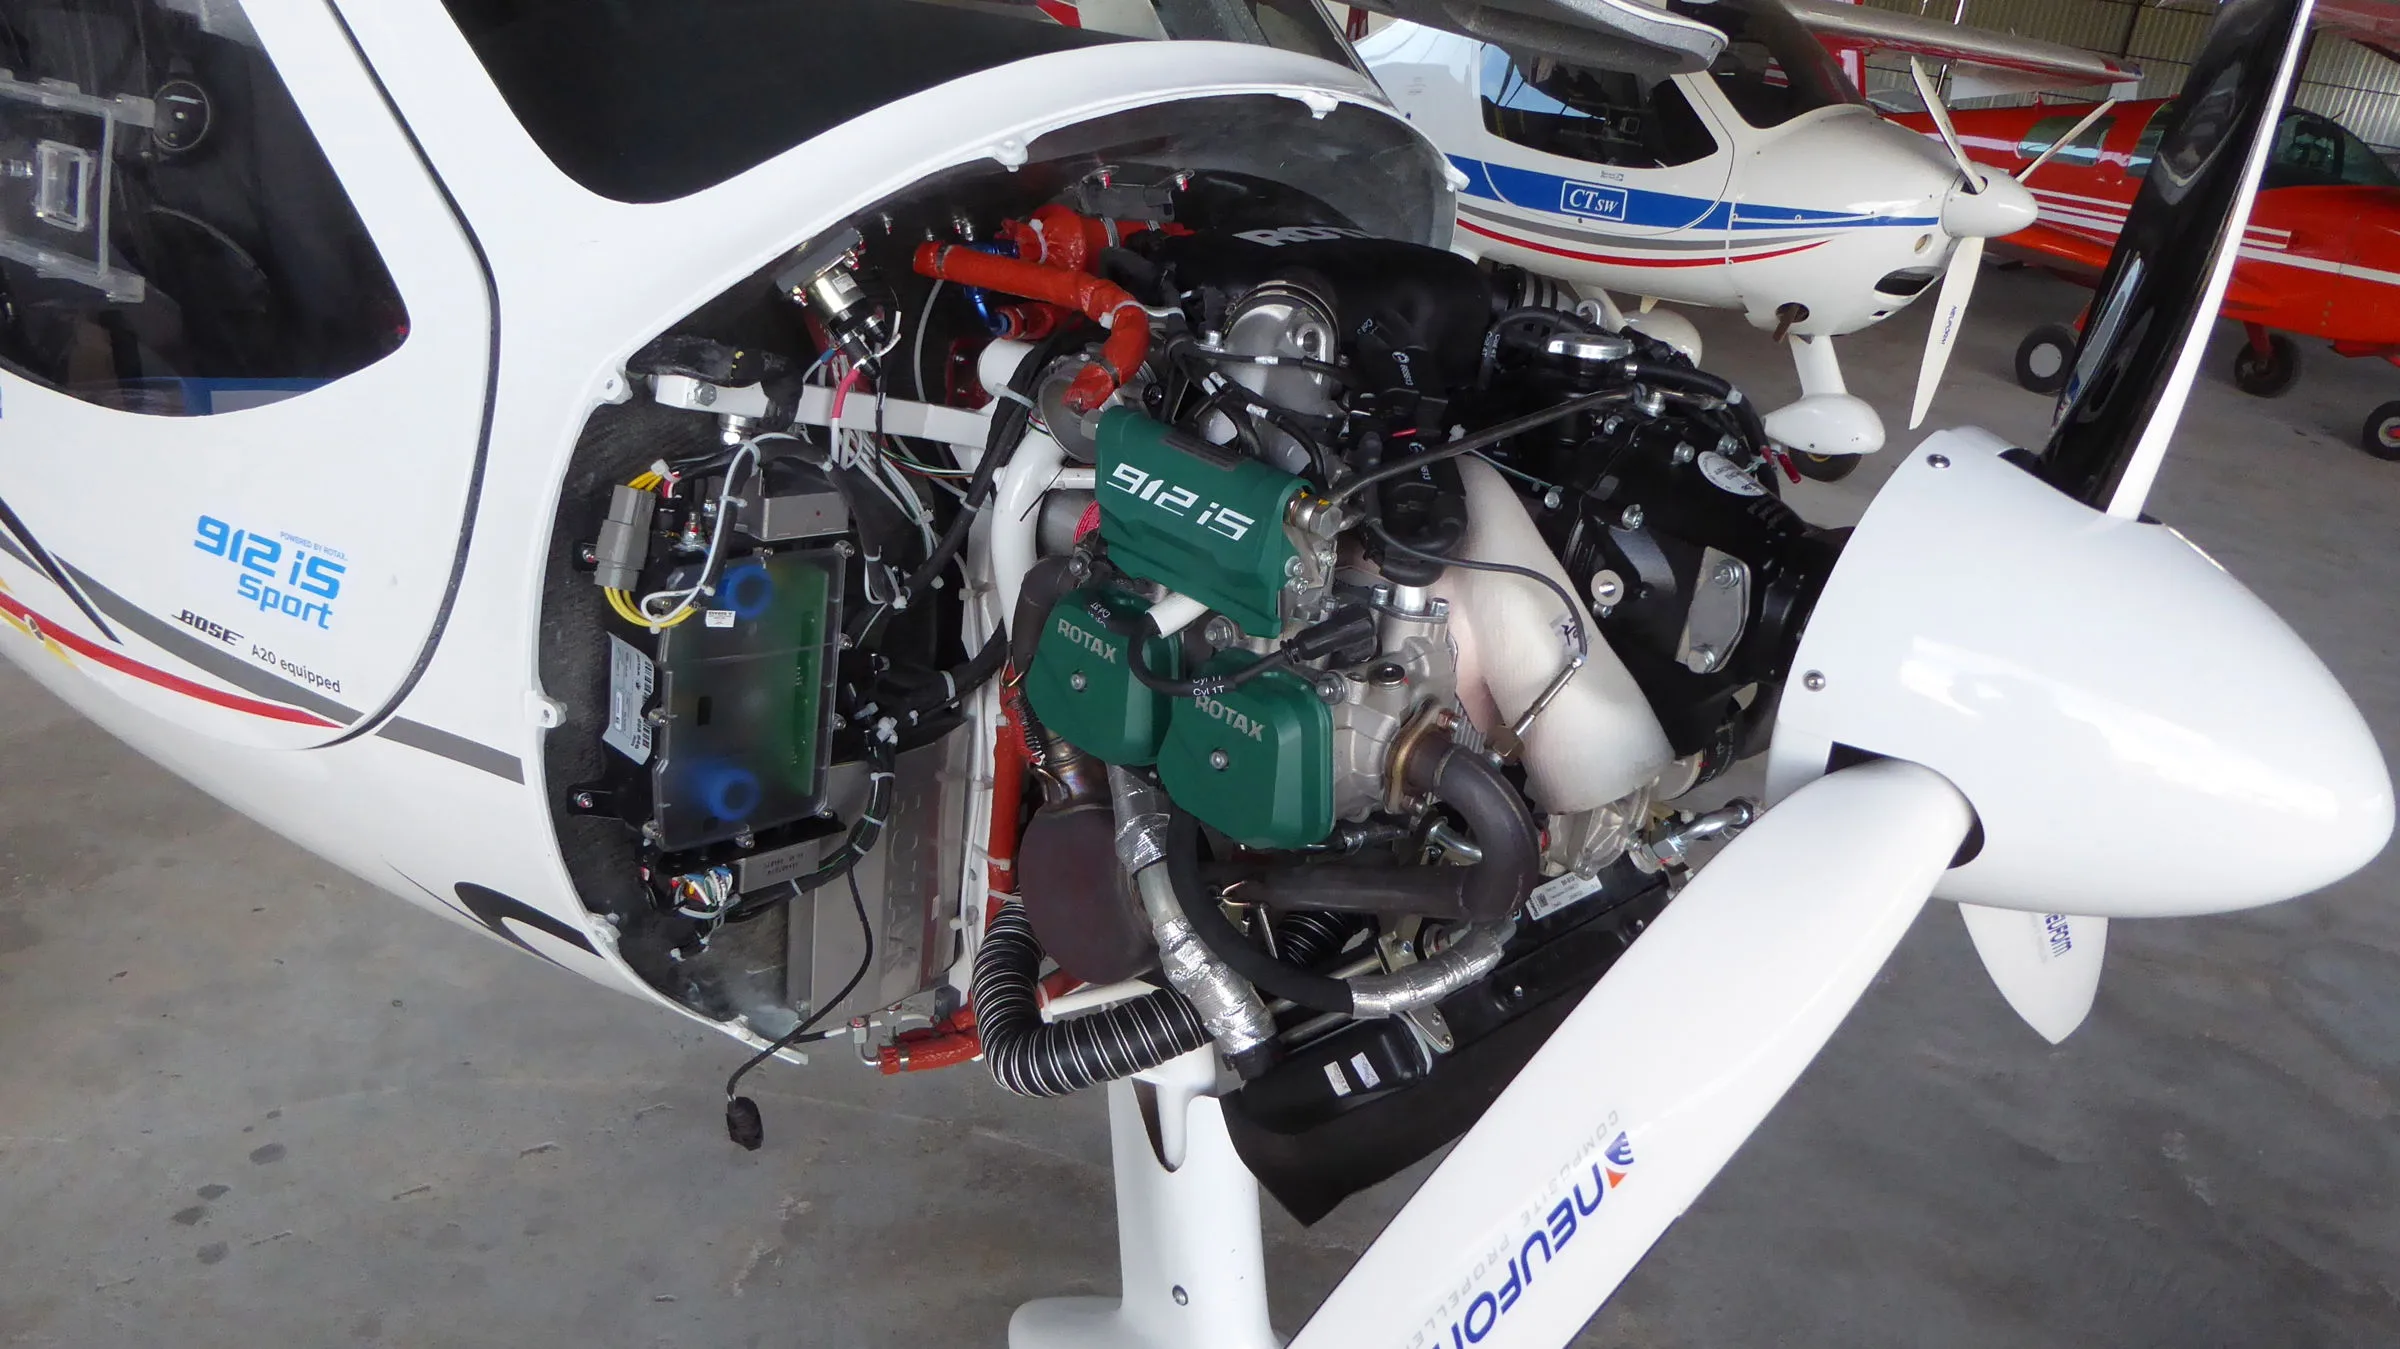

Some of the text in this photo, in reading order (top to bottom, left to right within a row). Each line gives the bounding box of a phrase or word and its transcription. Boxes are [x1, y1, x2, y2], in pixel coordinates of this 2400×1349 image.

[1106, 462, 1200, 517] 912
[193, 514, 347, 600] 912 iS
[280, 531, 313, 549] POWERED
[313, 543, 323, 553] BY
[171, 608, 245, 646] BOSE
[1057, 617, 1117, 665] ROTAX
[251, 643, 342, 693] A20 equipped
[1192, 688, 1210, 697] Cyl
[1195, 694, 1266, 743] ROTAX
[1405, 1109, 1619, 1349] COMPOSITE PROPELLE
